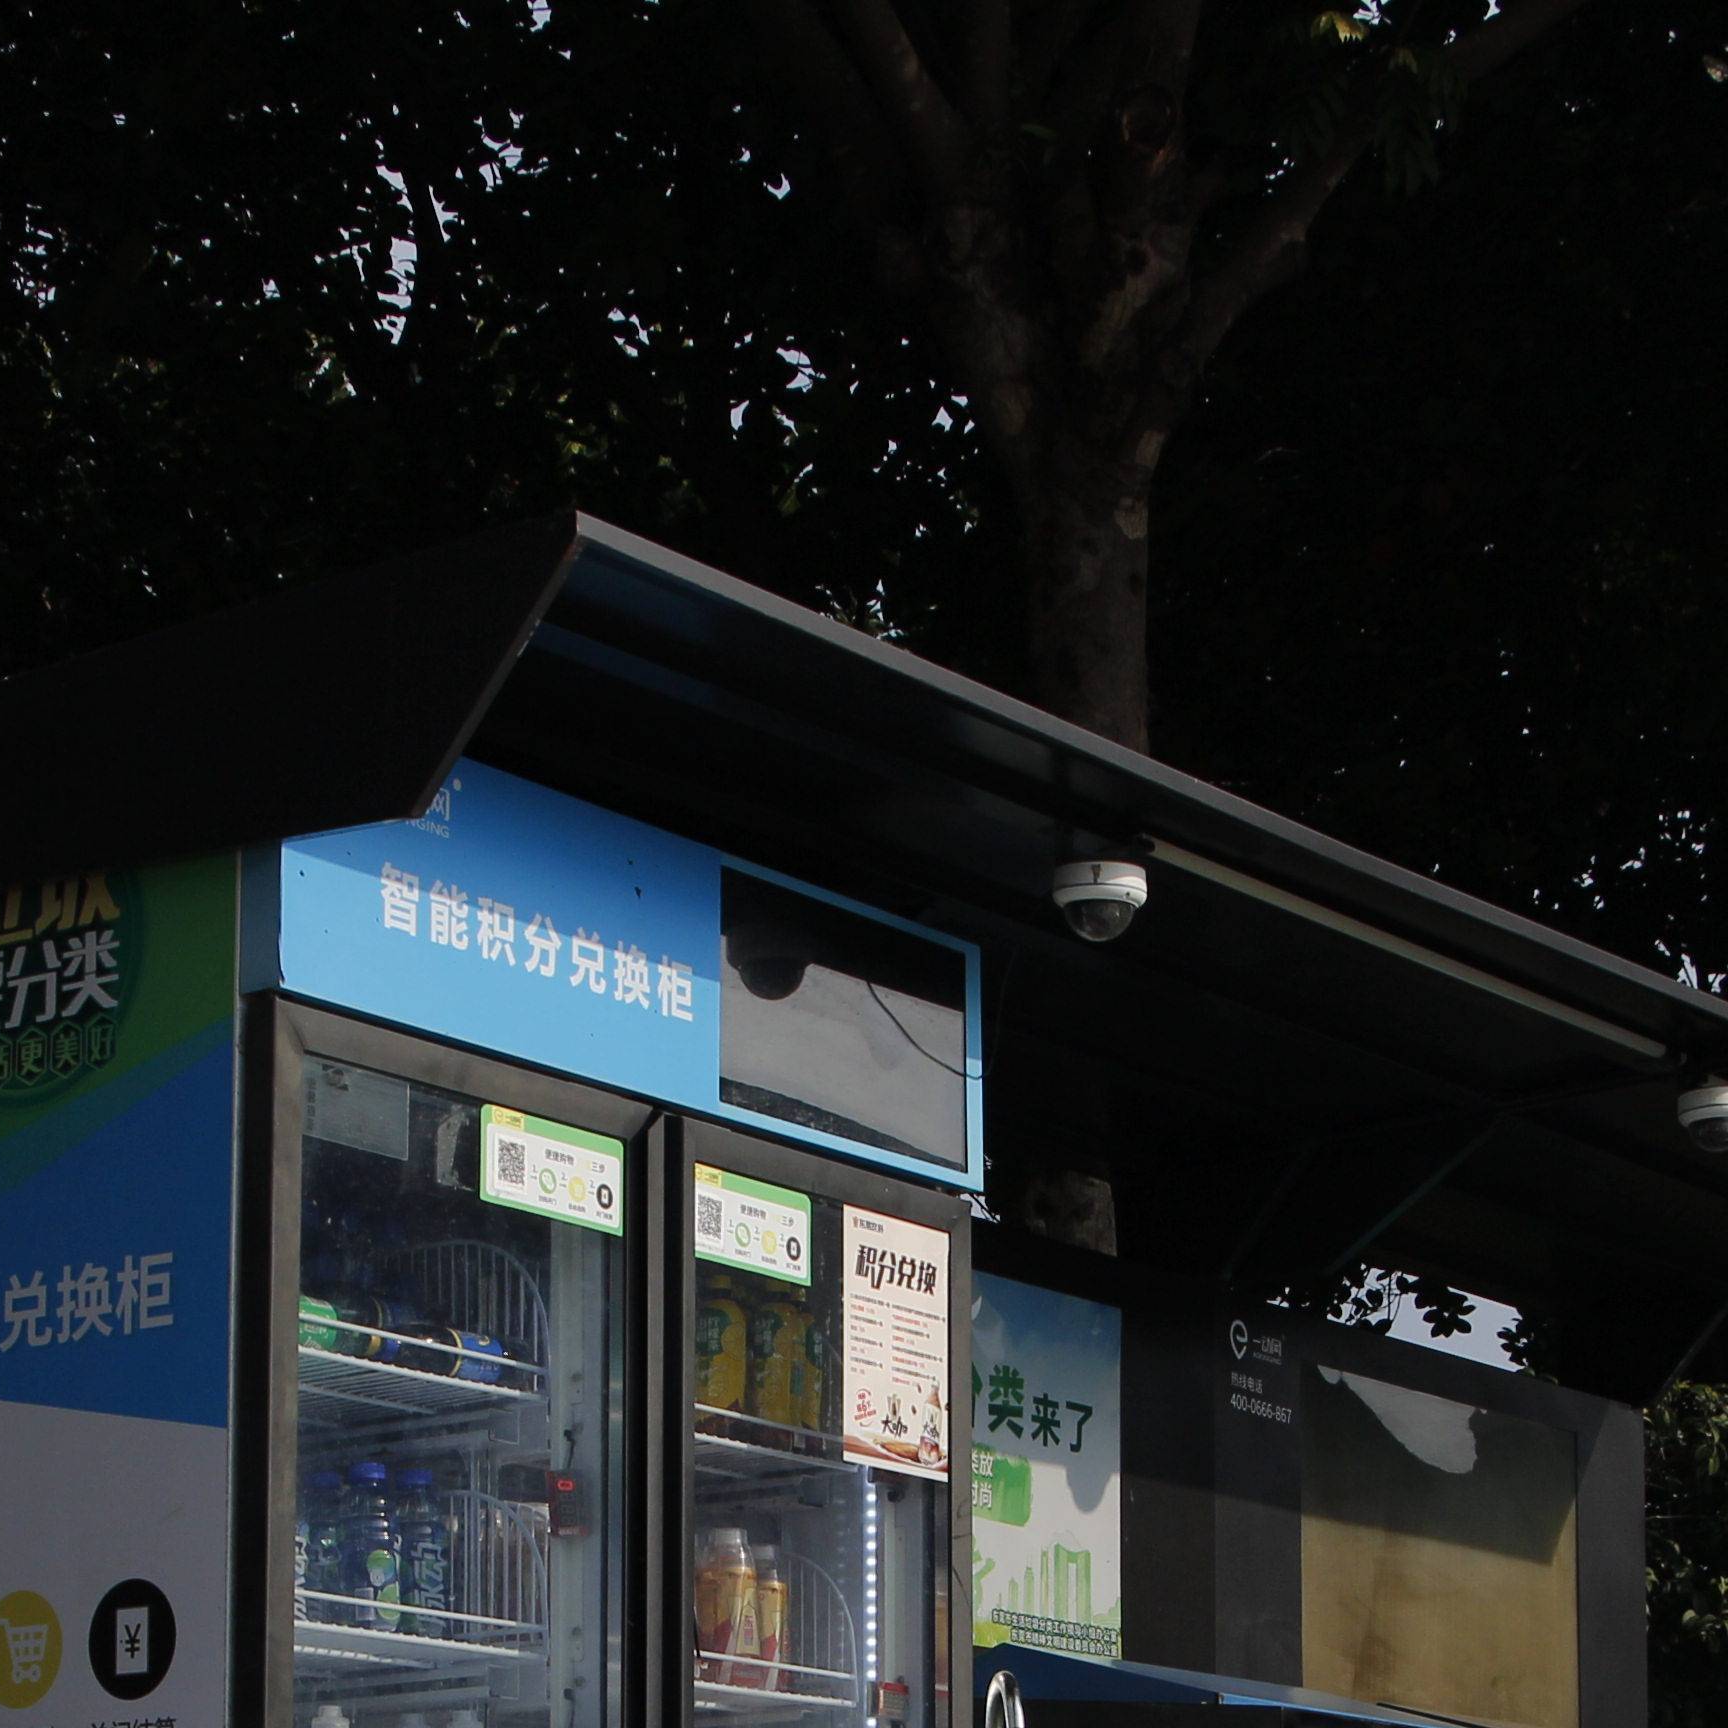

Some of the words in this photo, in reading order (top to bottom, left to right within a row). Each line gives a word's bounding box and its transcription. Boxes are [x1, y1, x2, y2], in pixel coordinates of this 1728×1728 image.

[379, 862, 694, 1023] 智能积分兑换柜
[855, 1244, 938, 1296] 积分兑换
[972, 1362, 1093, 1453] 类来了
[1230, 1392, 1293, 1425] 400-0666-867
[1231, 1371, 1264, 1395] 热线电话
